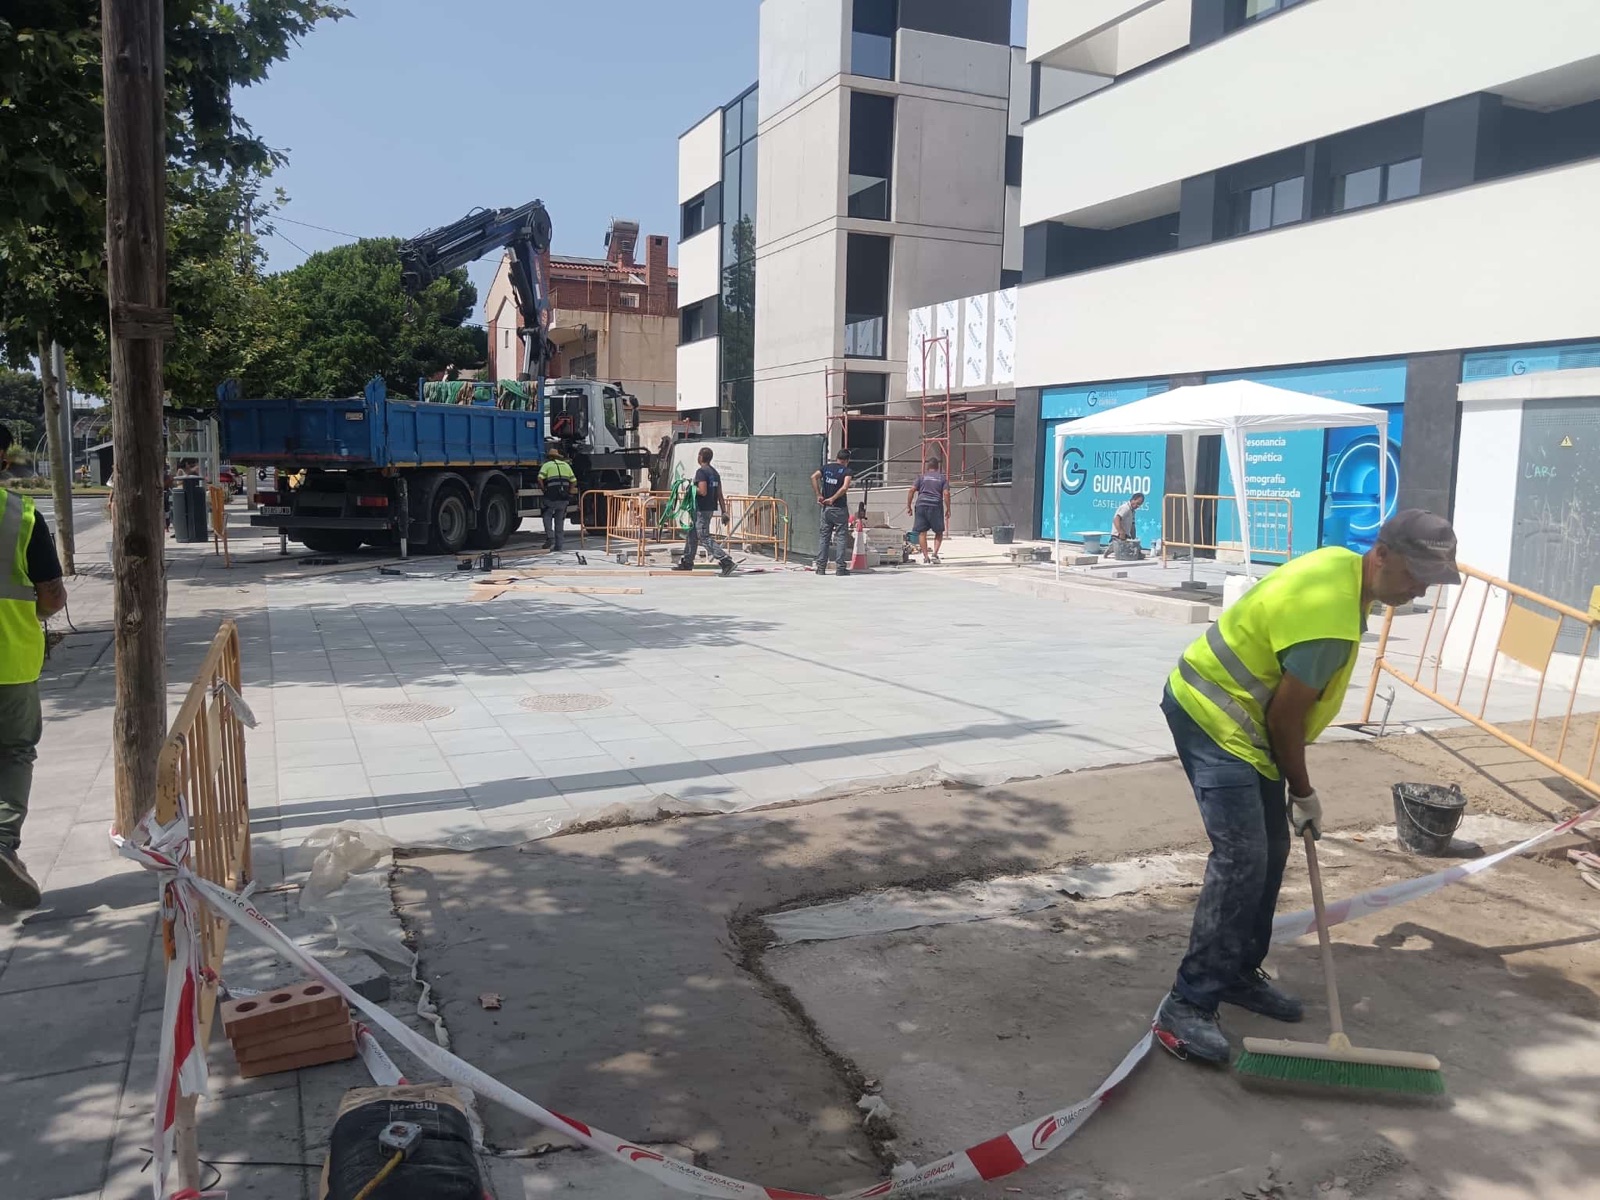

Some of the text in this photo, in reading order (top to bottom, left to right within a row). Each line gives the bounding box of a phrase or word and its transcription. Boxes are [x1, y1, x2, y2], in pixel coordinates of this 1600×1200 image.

[1244, 436, 1286, 447] esonancia
[1094, 450, 1152, 470] INSTITUTS
[1093, 474, 1151, 495] GUIRADO
[1244, 473, 1286, 486] omografía
[1244, 487, 1301, 498] omputarizada
[923, 1161, 955, 1180] GRACIA
[703, 1174, 746, 1190] GRACIA
